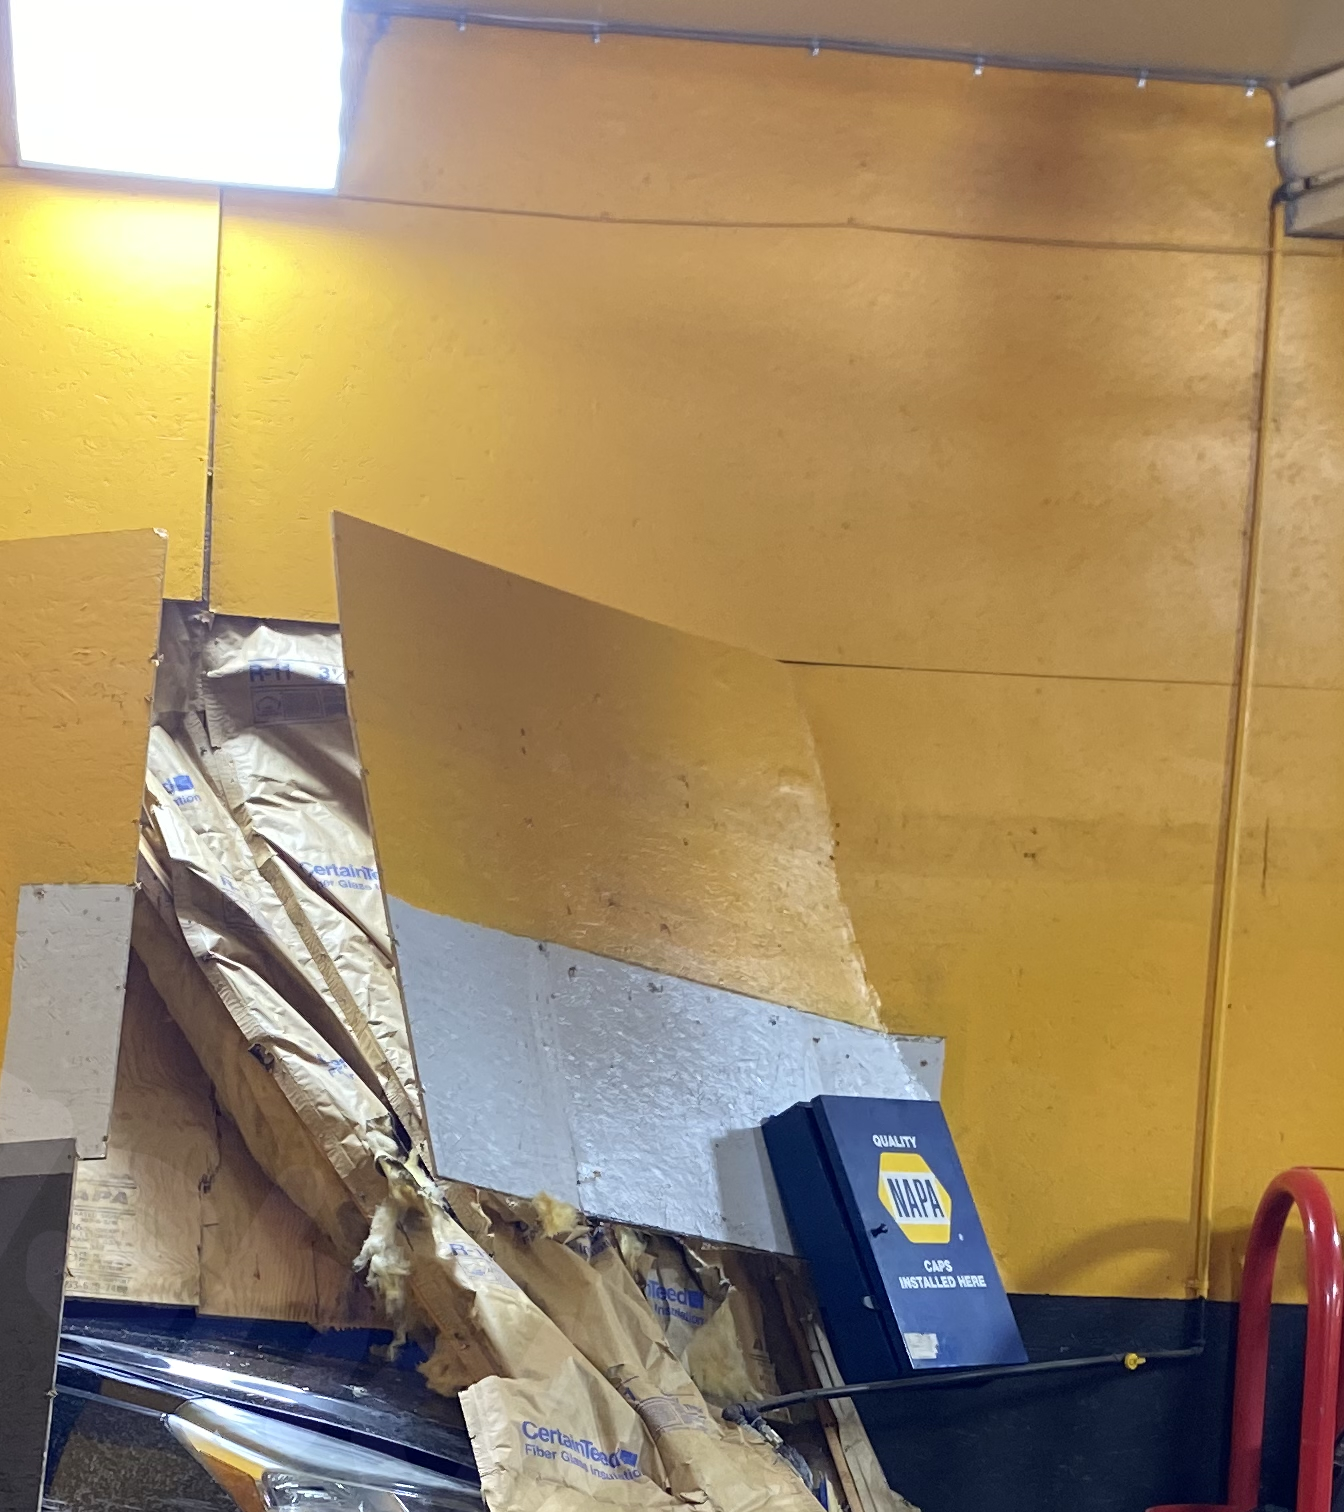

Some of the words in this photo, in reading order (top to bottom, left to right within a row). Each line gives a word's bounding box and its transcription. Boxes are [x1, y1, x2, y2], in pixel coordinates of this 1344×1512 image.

[872, 1134, 917, 1149] QUALITY
[887, 1178, 945, 1218] NAPA
[924, 1260, 952, 1273] CAPS
[899, 1276, 956, 1289] INSTALLED
[958, 1275, 987, 1288] HERE
[525, 1443, 557, 1460] Fiber
